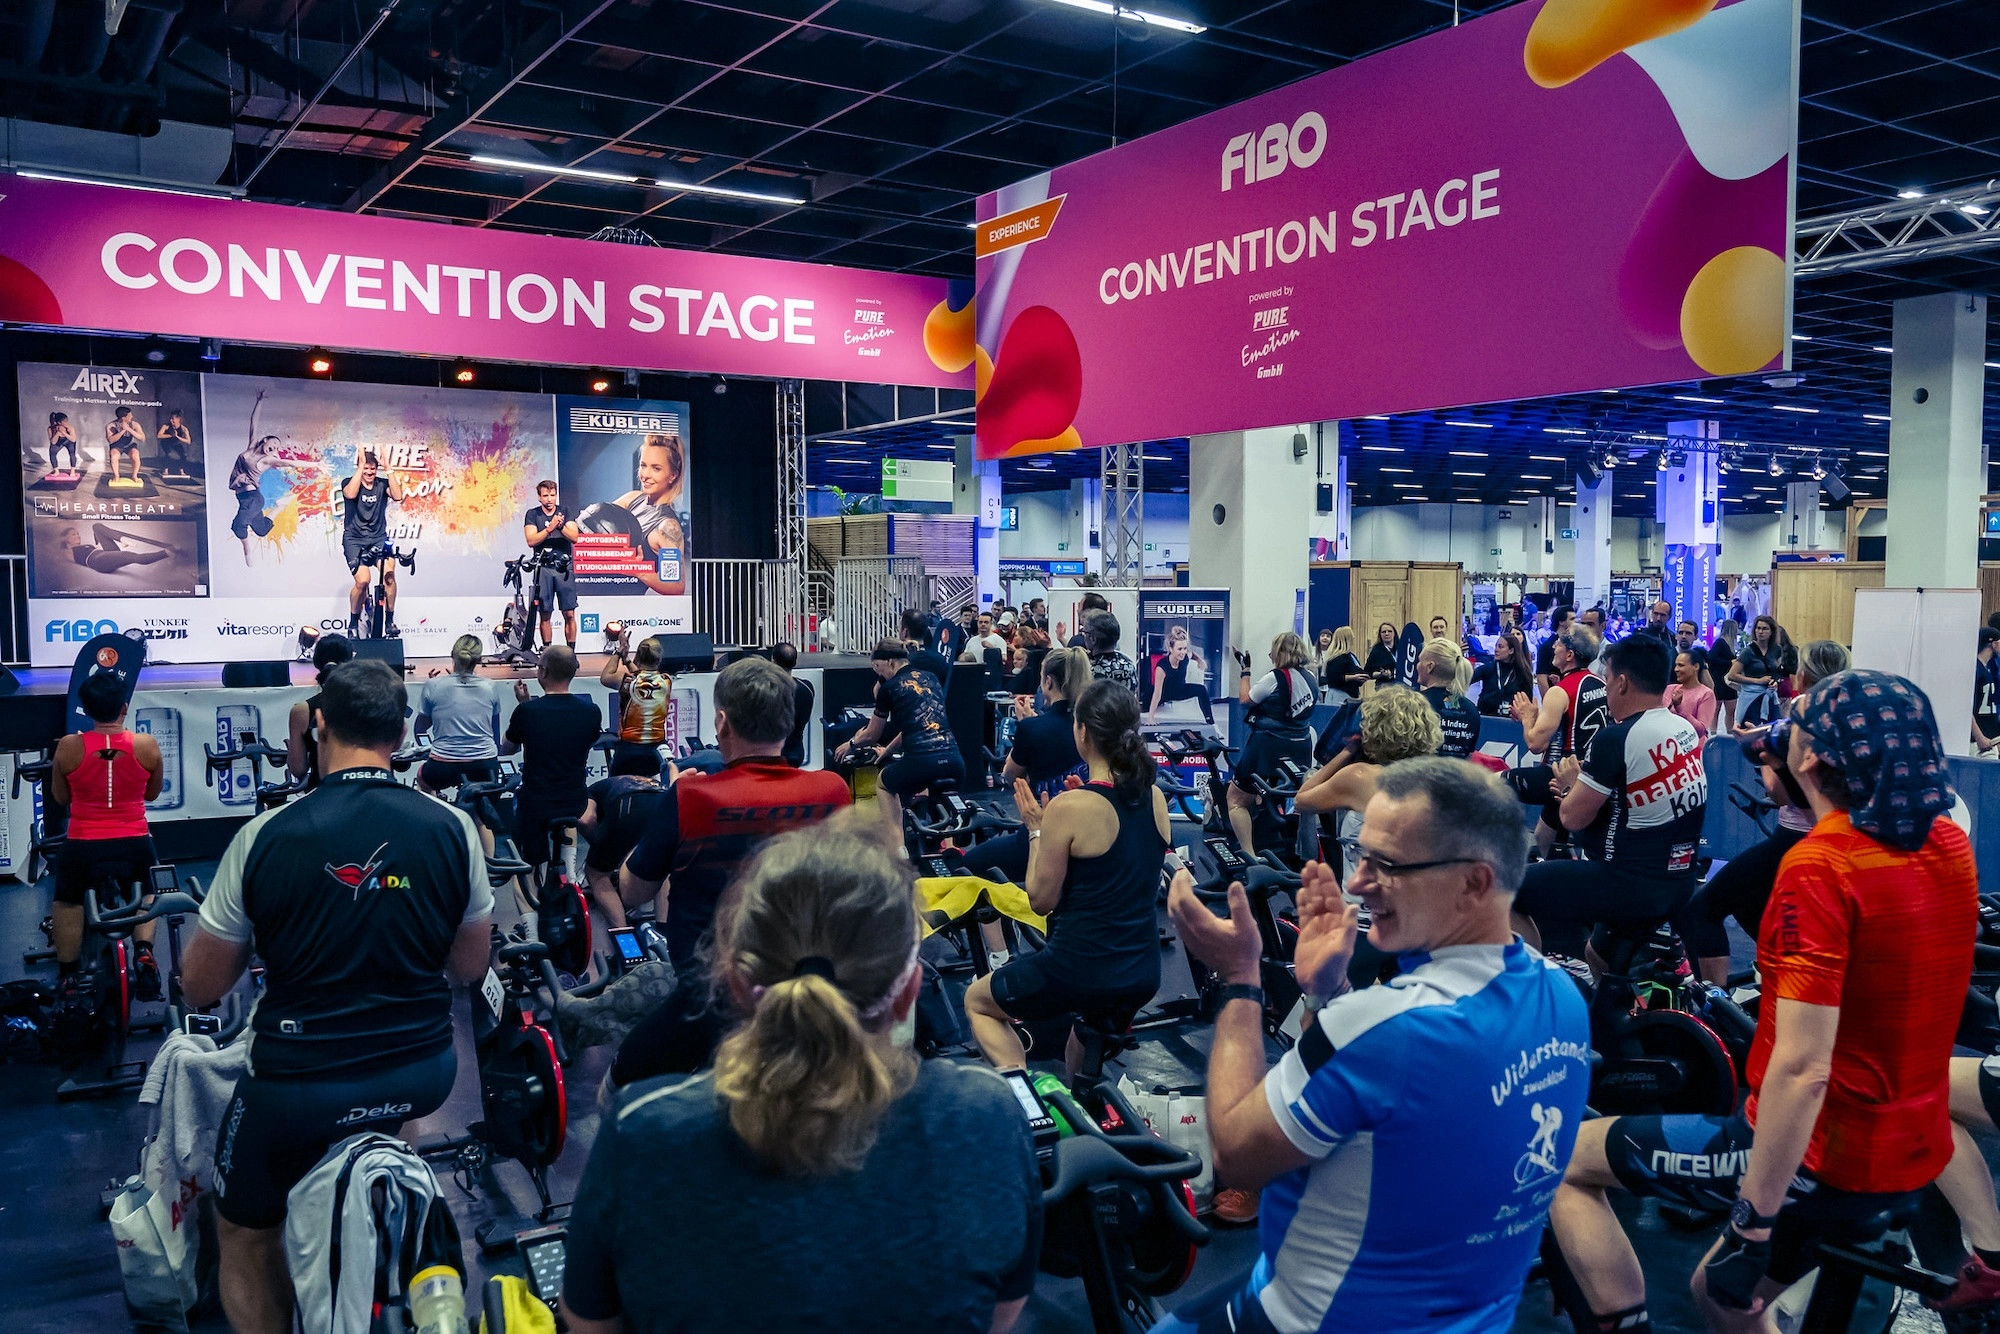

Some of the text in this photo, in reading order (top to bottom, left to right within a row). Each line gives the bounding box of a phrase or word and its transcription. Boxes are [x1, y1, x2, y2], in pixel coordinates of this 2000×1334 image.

[1221, 110, 1328, 192] FIBO
[989, 215, 1040, 243] EXPERIENCE
[1099, 168, 1501, 305] CONVENTION STAGE
[101, 232, 816, 345] CONVENTION STAGE
[1248, 285, 1294, 304] powered by
[854, 309, 885, 323] PURE
[1252, 306, 1289, 327] PURE
[843, 326, 894, 345] Emotion
[858, 347, 881, 357] GmbH
[1241, 327, 1300, 367] Emotion
[1256, 363, 1284, 379] GmbH
[70, 367, 140, 398] AIREX
[53, 396, 82, 404] Trainings
[588, 413, 661, 430] KÜBLER
[60, 502, 166, 514] HEARTBEAT
[988, 498, 994, 507] C
[989, 510, 994, 519] 3
[386, 522, 423, 539] mbH
[575, 563, 653, 571] STUDIOAUSSTATTUNG
[1676, 556, 1684, 584] AREA
[1157, 603, 1211, 614] KÜBLER
[144, 618, 188, 626] YUNKER
[217, 619, 294, 638] vitaresorp
[1402, 642, 1417, 687] ICG
[668, 703, 676, 754] OLLAB
[218, 720, 230, 796] COLAB
[1648, 738, 1678, 771] K2
[342, 770, 388, 780] rose.de
[715, 803, 839, 822] SCOTT
[368, 875, 411, 890] AIDA
[348, 1102, 412, 1121] Deka
